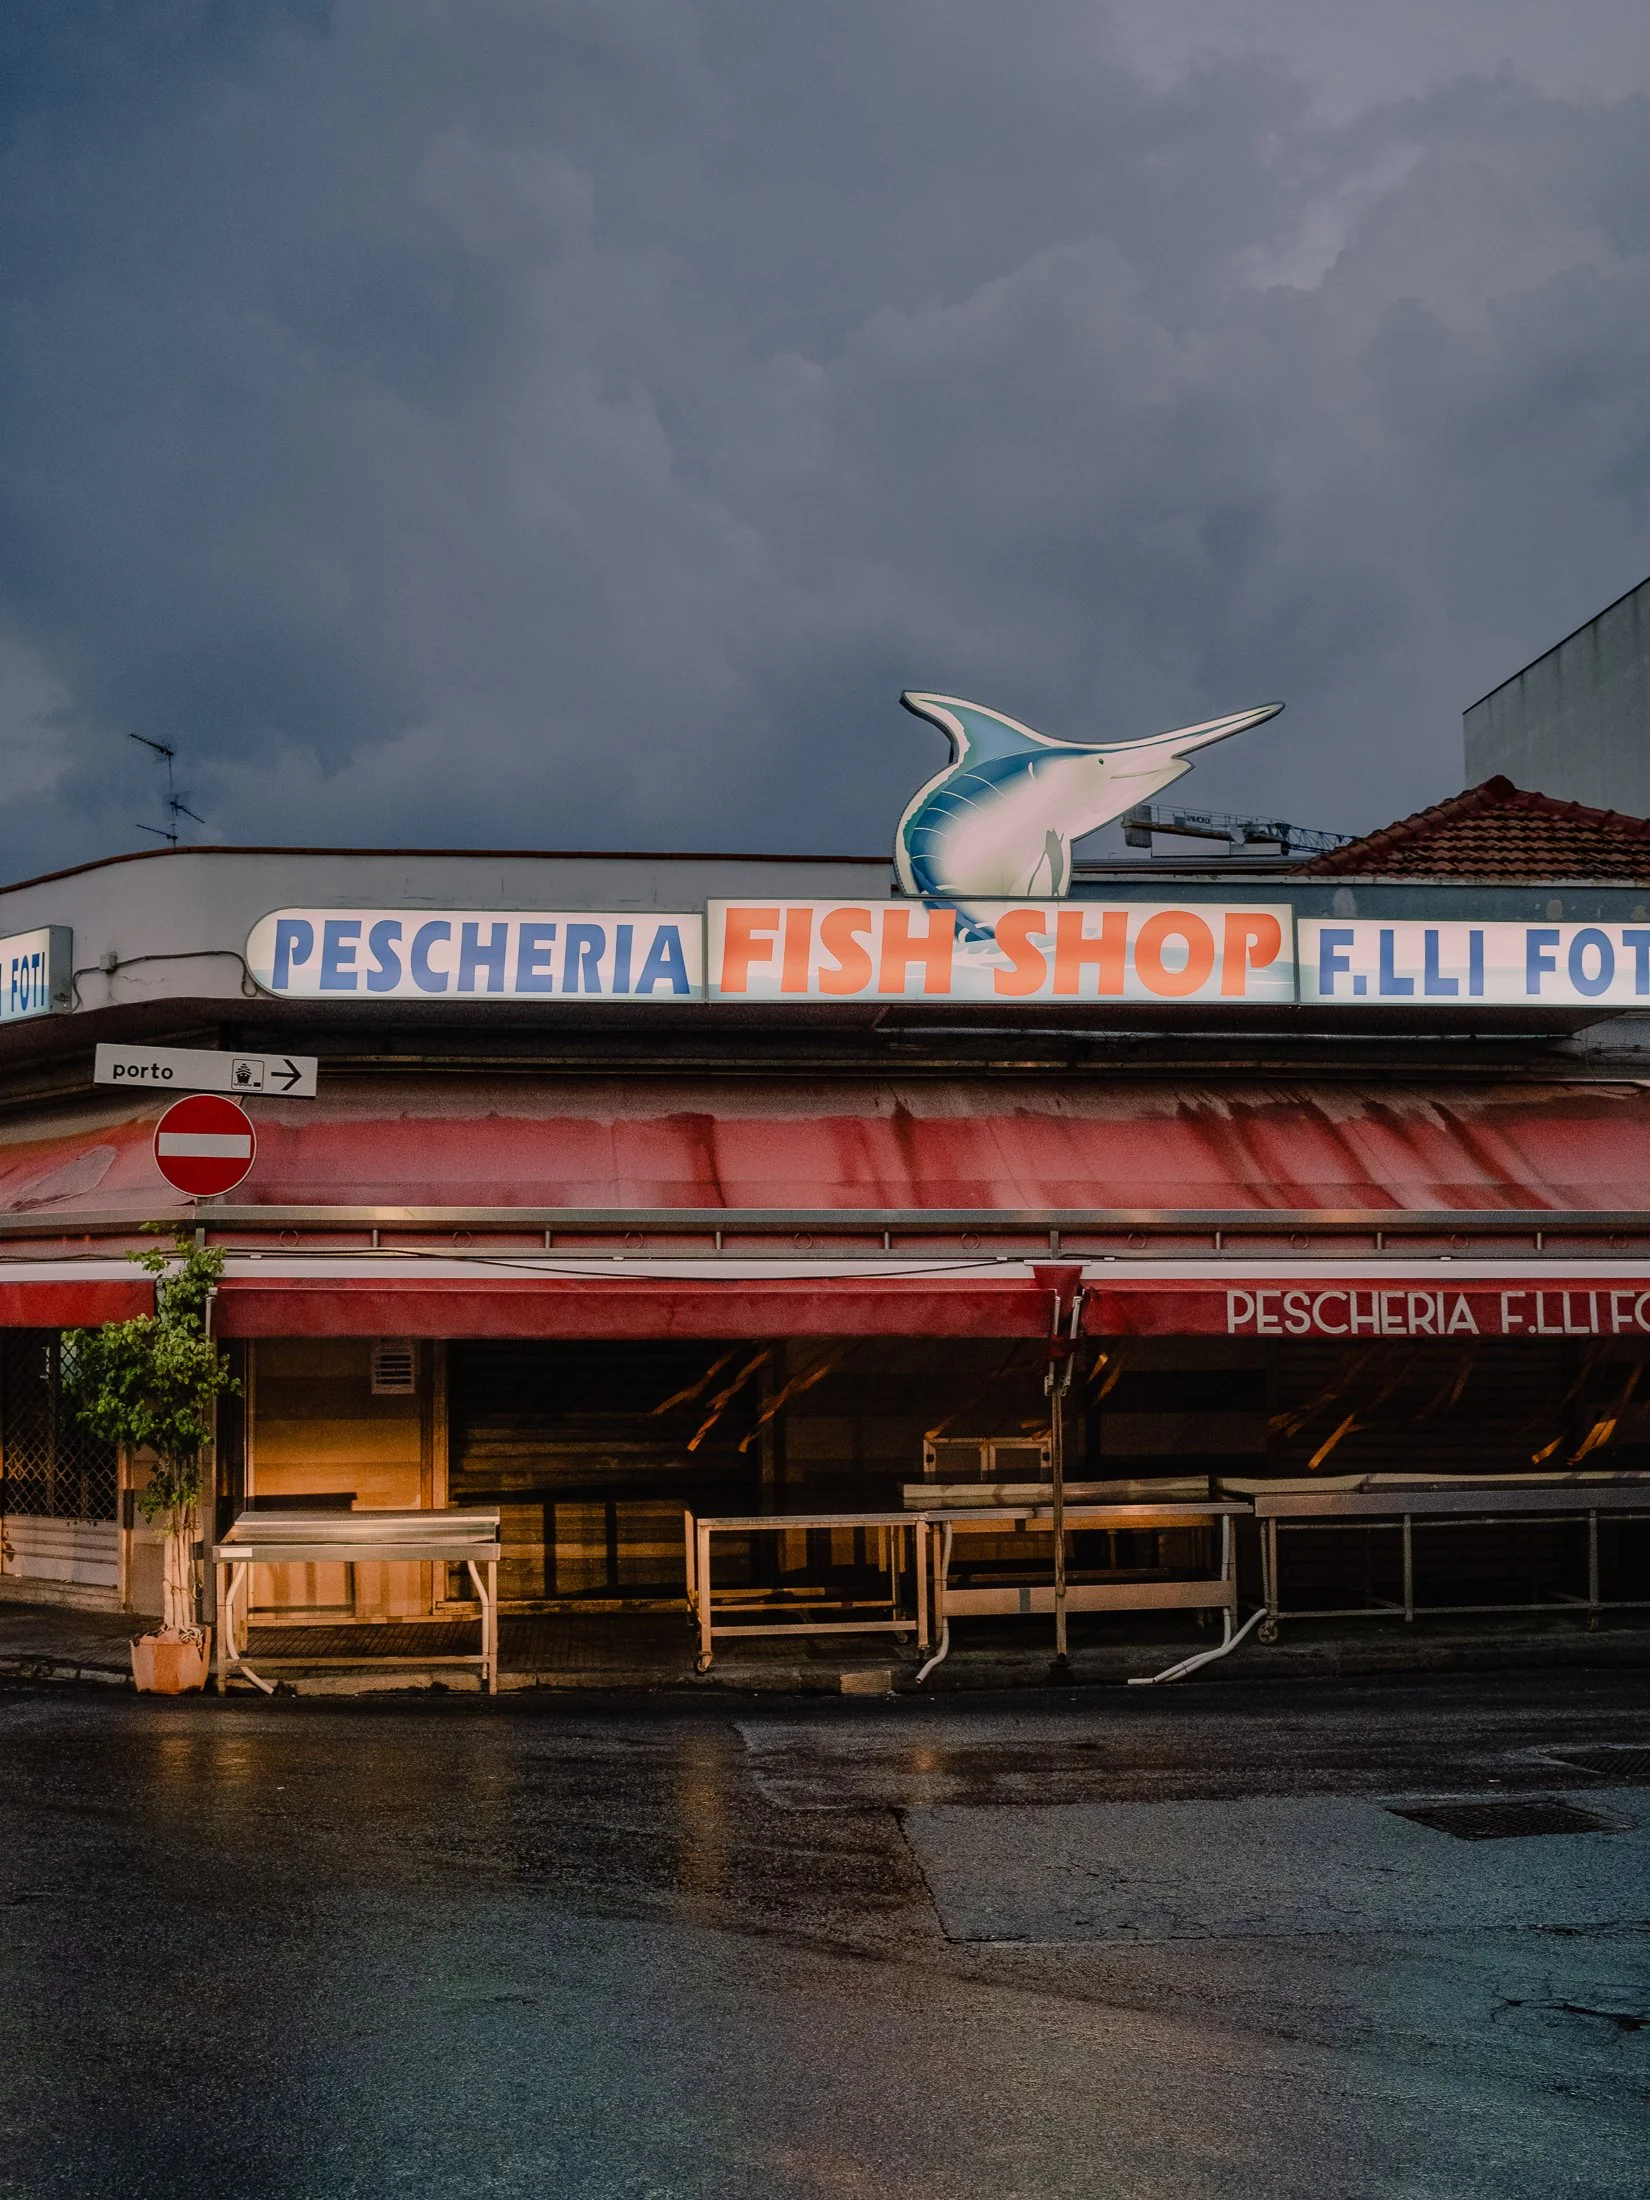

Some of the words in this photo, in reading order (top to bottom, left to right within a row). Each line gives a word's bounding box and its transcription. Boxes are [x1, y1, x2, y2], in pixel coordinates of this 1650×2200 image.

[11, 951, 45, 1013] FOTI
[272, 919, 692, 995] PESCHERIA
[720, 907, 957, 995] FISH
[993, 908, 1283, 997] SHOP
[1319, 928, 1484, 996] F.LLI
[113, 1063, 174, 1080] porto
[1226, 1290, 1480, 1335] PESCHERIA
[1500, 1290, 1599, 1334] F.LLI
